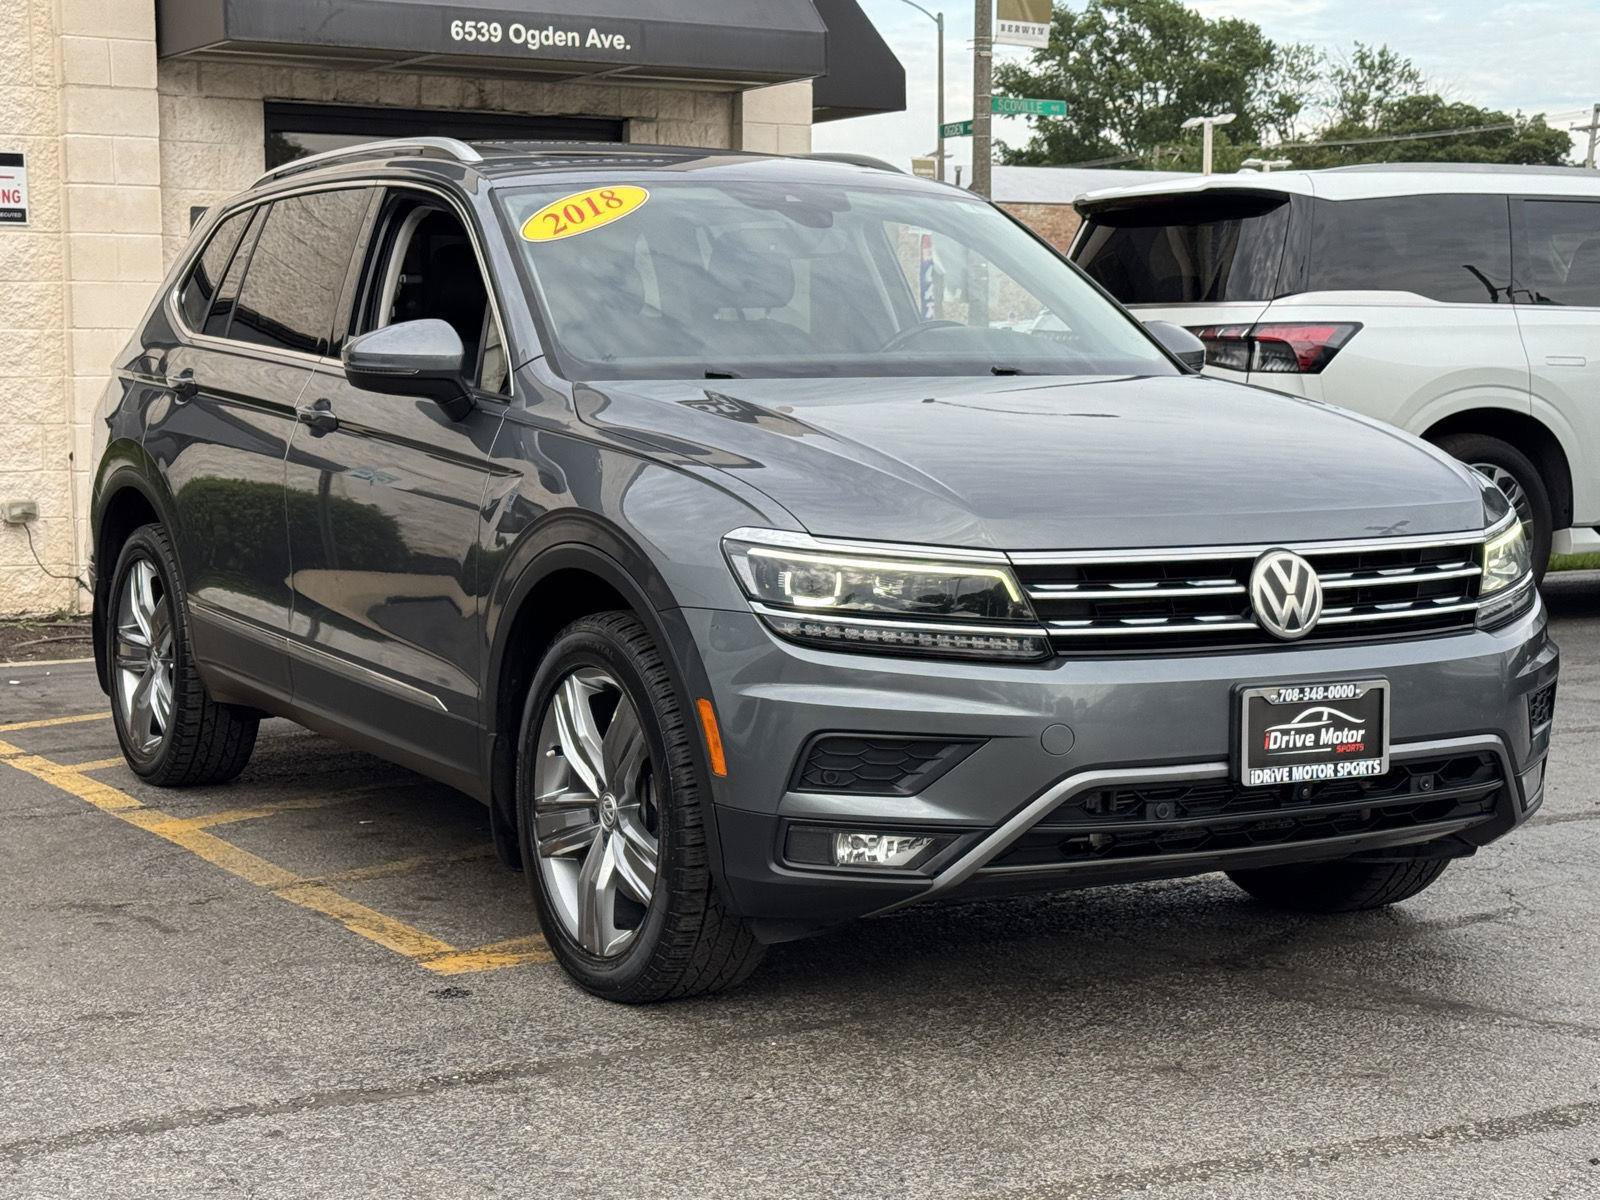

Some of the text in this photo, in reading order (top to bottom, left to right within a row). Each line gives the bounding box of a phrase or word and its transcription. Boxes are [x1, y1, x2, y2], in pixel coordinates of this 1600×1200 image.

[450, 20, 631, 50] 6539 Ogden Ave.
[542, 190, 624, 236] 2018
[1279, 685, 1354, 702] 708-348-0000
[1264, 727, 1366, 750] iDrive Motor
[1336, 743, 1365, 753] SPORTS
[1292, 764, 1334, 781] MOTOR
[1337, 760, 1380, 777] SPORTS
